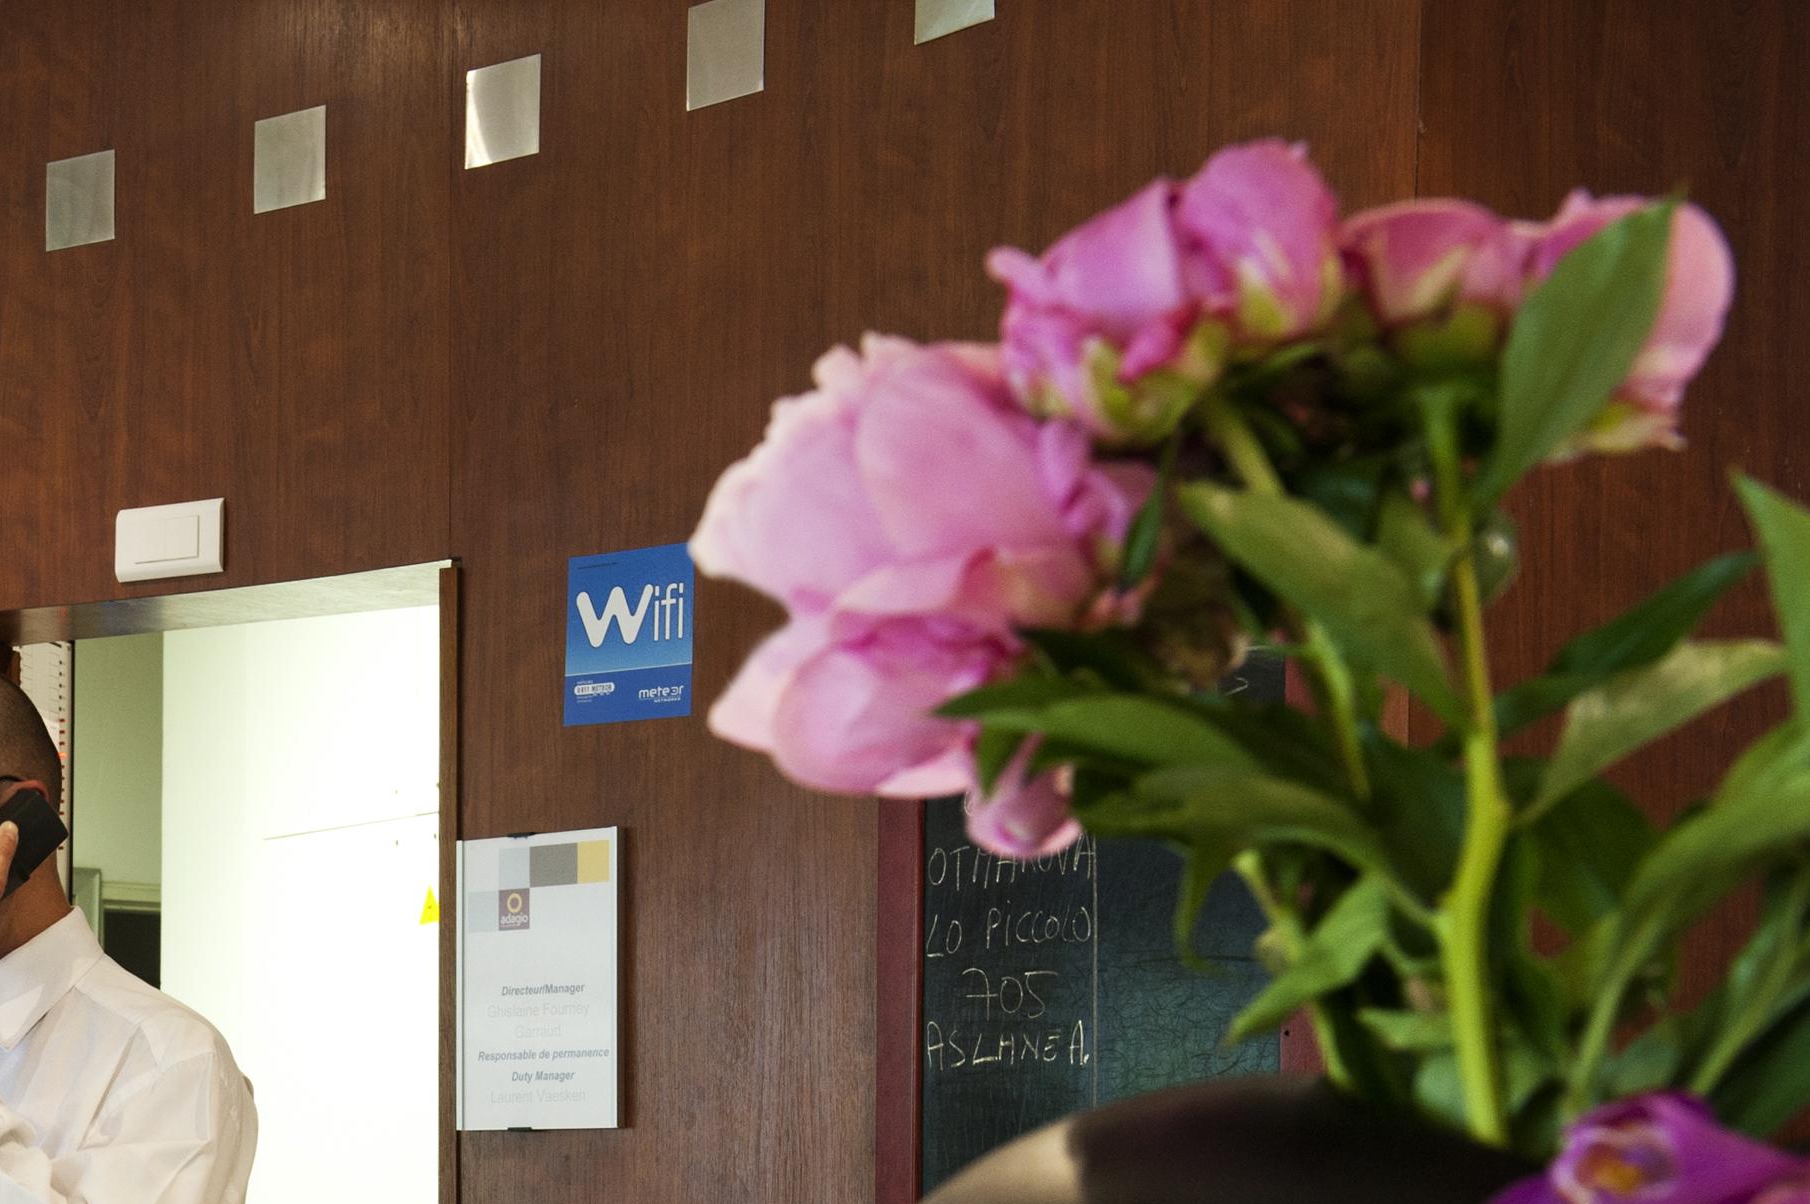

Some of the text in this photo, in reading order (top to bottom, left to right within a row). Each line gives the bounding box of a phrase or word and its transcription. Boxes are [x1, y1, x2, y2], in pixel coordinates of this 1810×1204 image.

[576, 583, 684, 648] Wifi
[962, 967, 1058, 1021] 705
[478, 1048, 609, 1063] Responsable de permanence
[511, 1070, 575, 1084] Duty Manager
